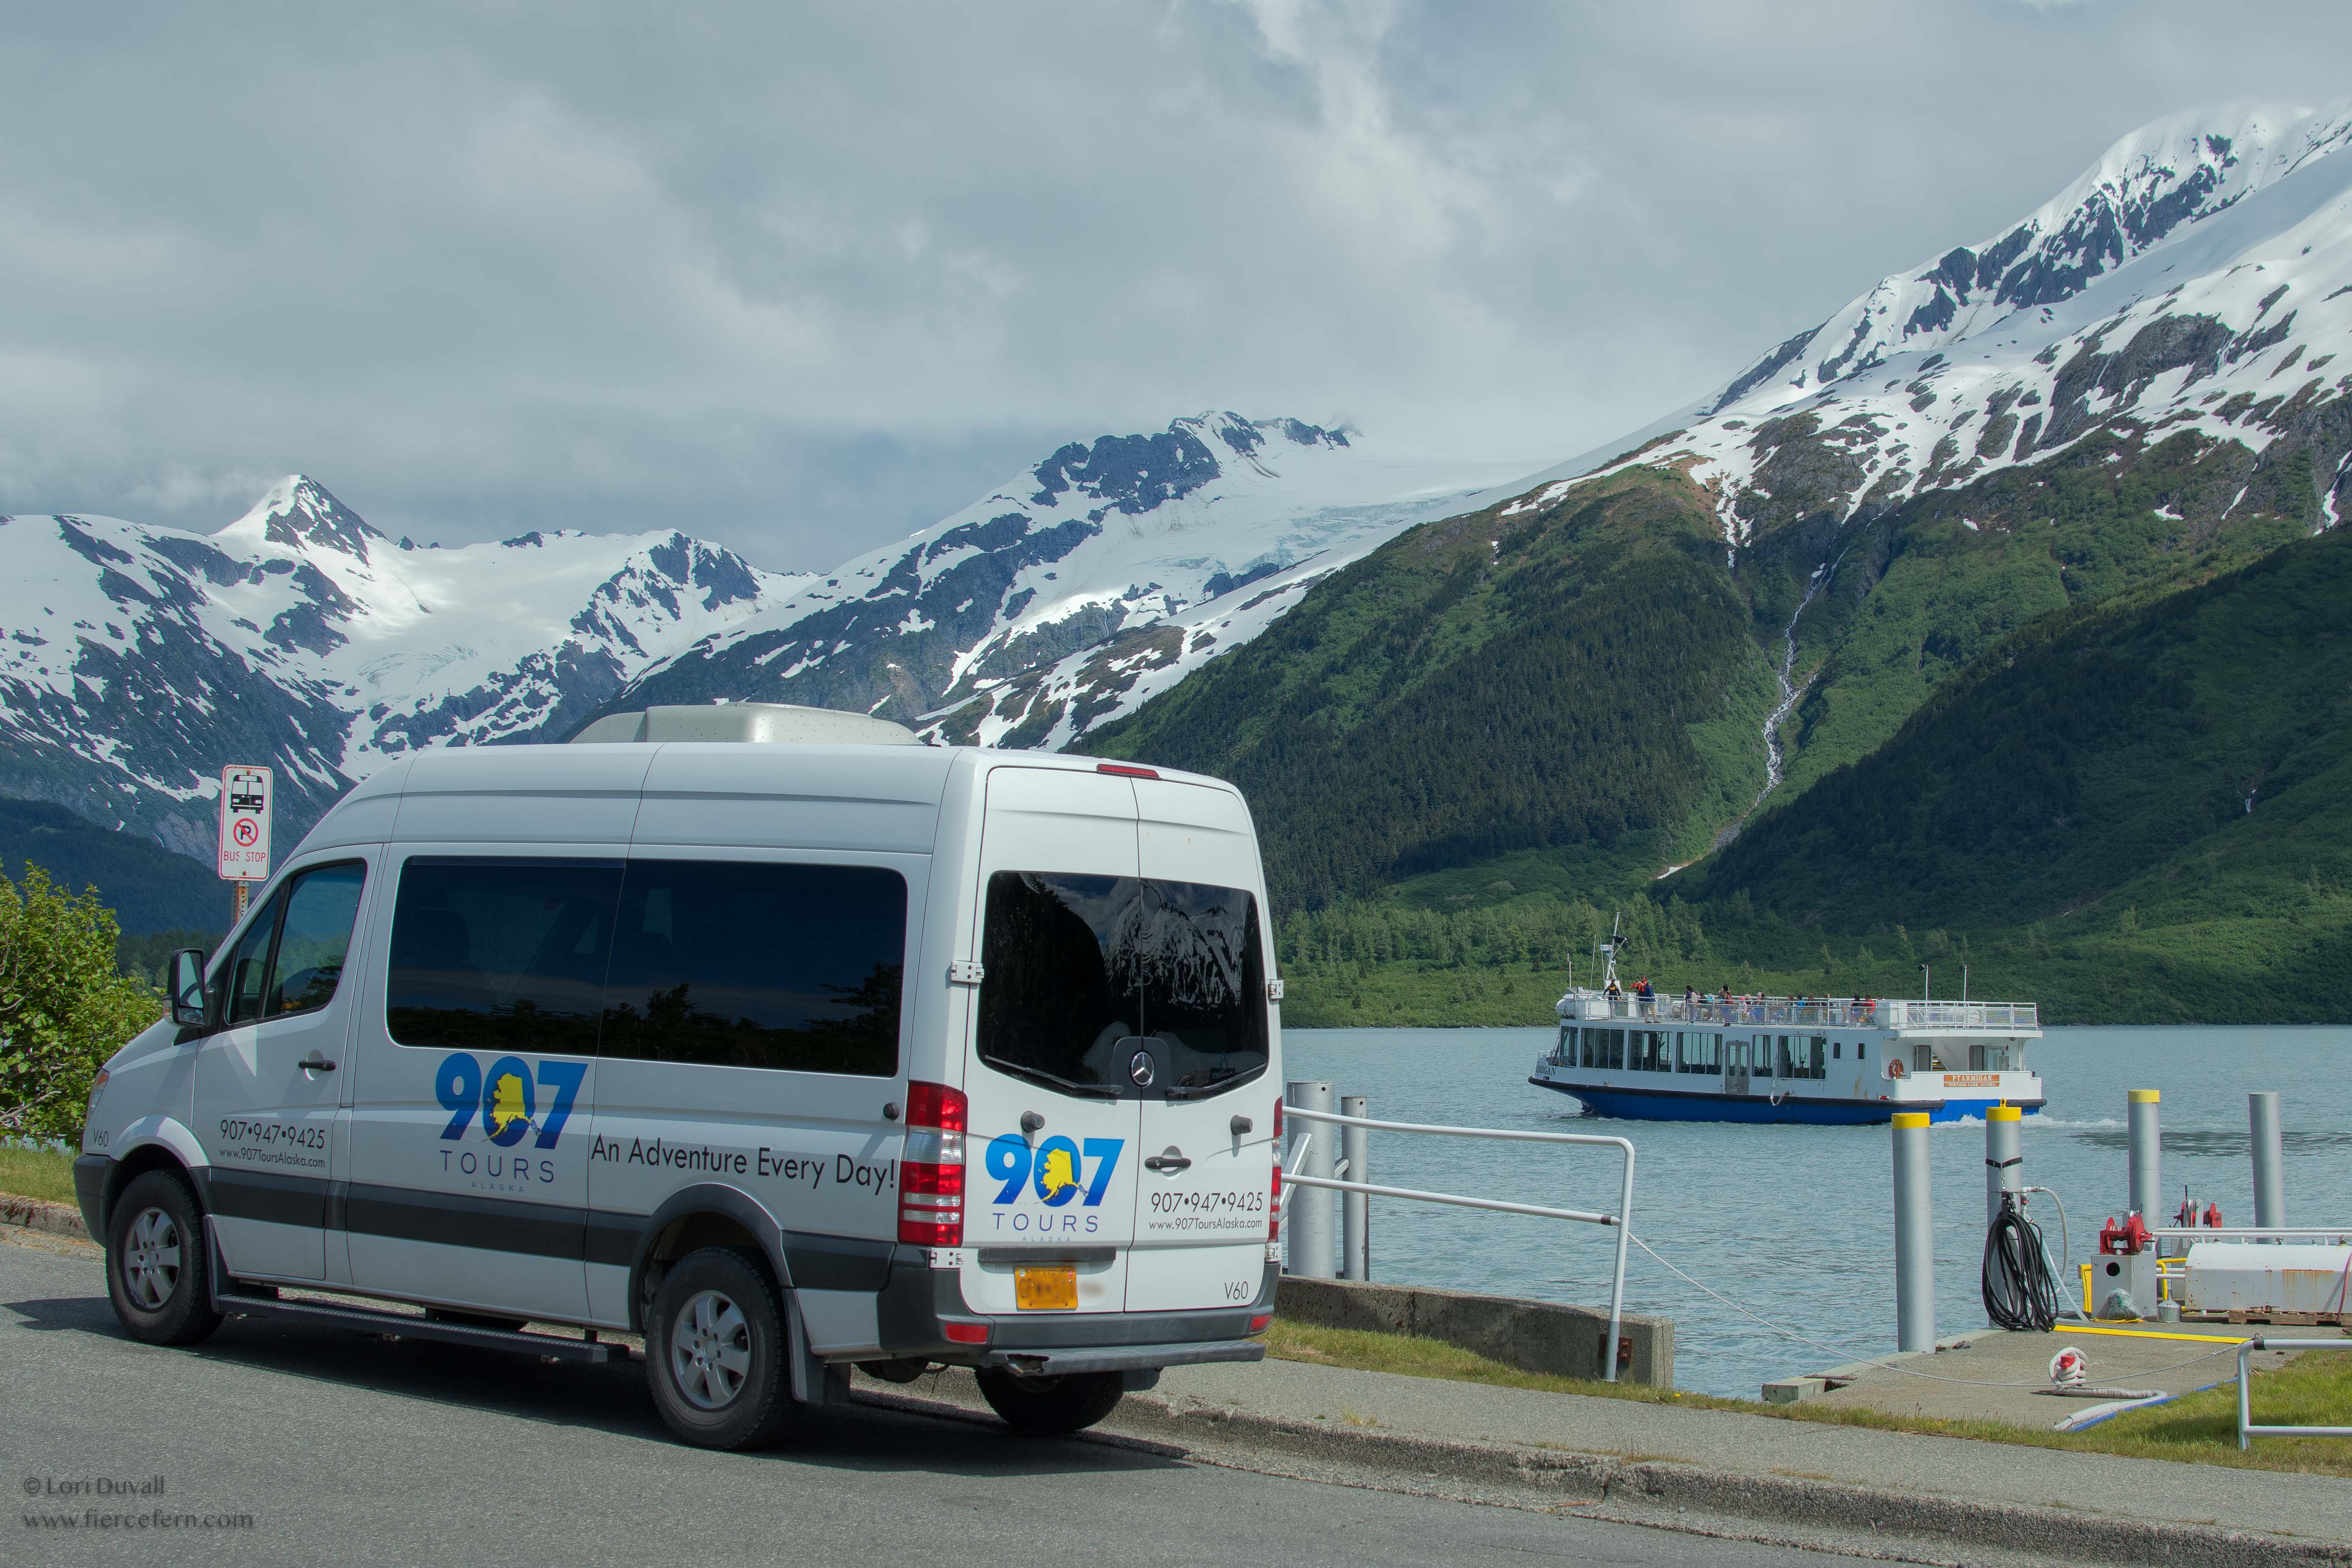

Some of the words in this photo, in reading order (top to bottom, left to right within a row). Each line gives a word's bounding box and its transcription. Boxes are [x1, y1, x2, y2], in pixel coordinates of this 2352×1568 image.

[223, 851, 240, 861] BUS
[245, 852, 266, 862] STOP
[435, 1052, 589, 1150] 907
[94, 1128, 109, 1147] V60
[220, 1147, 325, 1168] www.907ToursAlaska.com
[440, 1150, 555, 1183] TOURS
[591, 1132, 619, 1162] An
[628, 1135, 748, 1174] Adventure
[758, 1147, 825, 1189] Every
[836, 1153, 895, 1195] Day!
[986, 1133, 1125, 1207] 907
[472, 1181, 524, 1193] ALASKA
[992, 1213, 1099, 1232] TOURS
[1148, 1217, 1262, 1230] www.907ToursAlaska.com
[1224, 1281, 1248, 1300] V60
